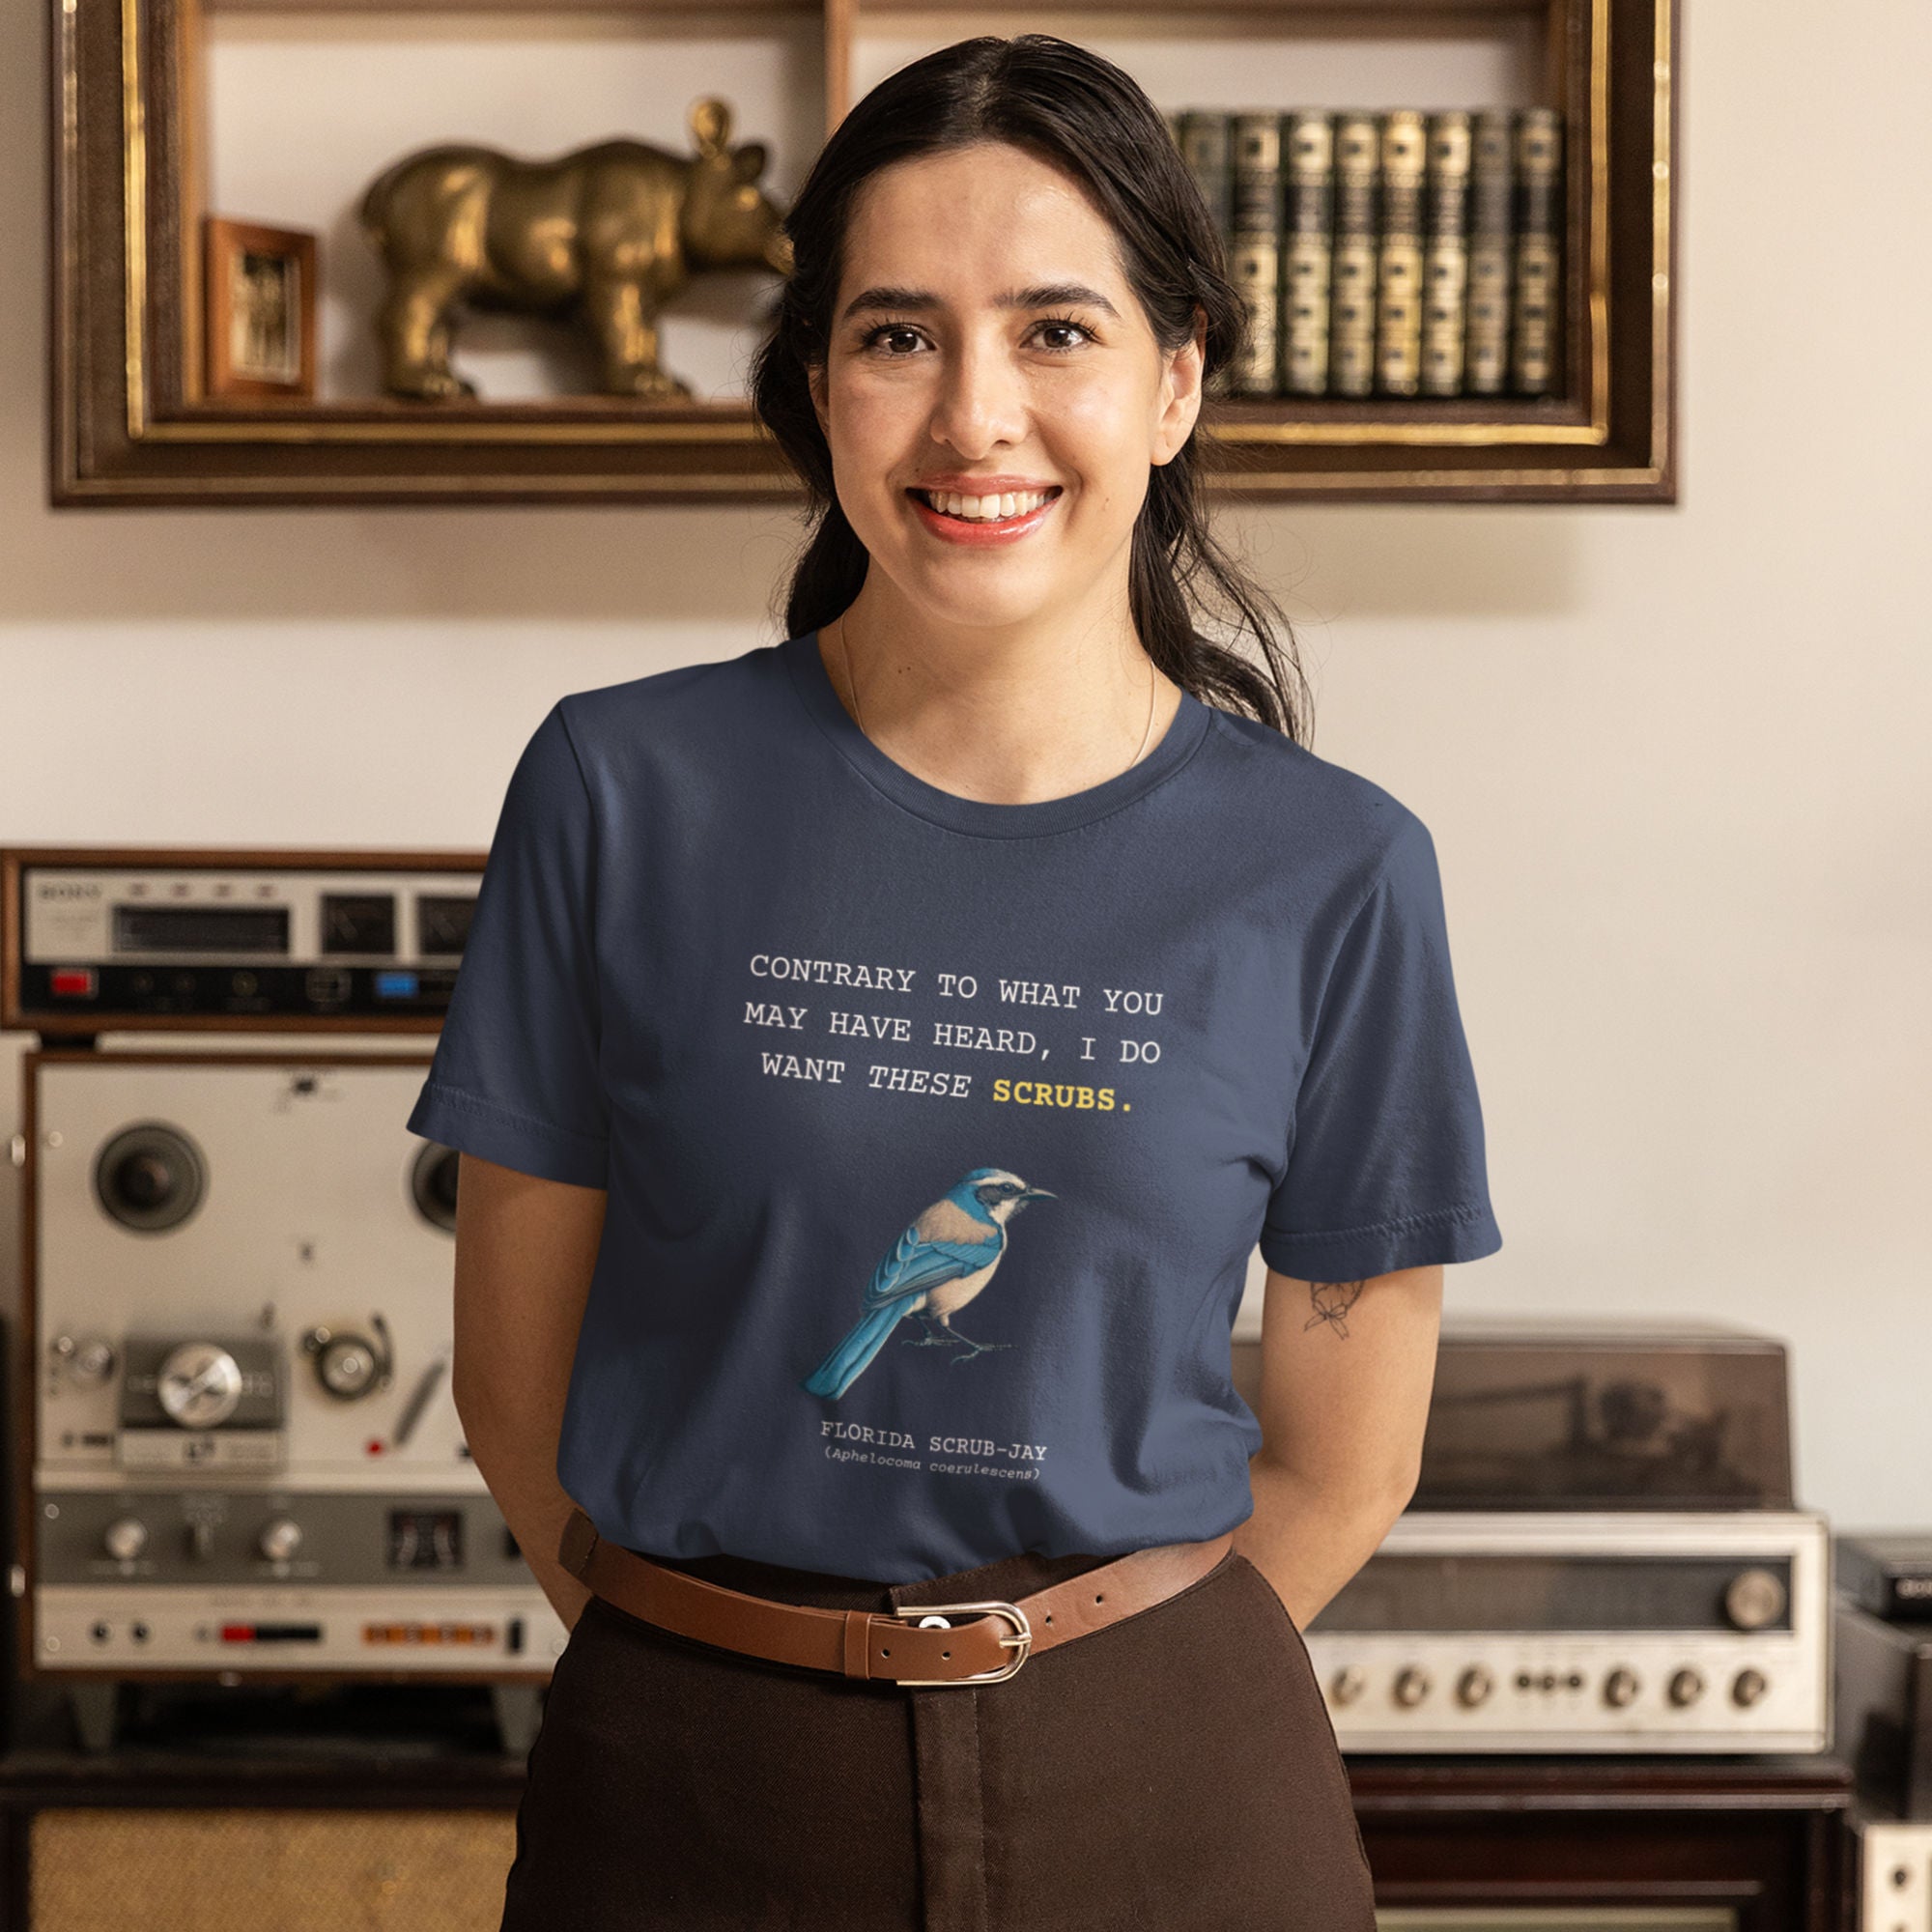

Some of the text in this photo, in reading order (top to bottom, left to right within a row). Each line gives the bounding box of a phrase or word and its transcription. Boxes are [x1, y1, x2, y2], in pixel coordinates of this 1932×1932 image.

[750, 954, 1164, 1015] CONTRARY TO WHAT YOU
[743, 1002, 1161, 1064] MAY HAVE HEARD, I DO
[761, 1053, 1131, 1112] WANT THESE SCRUBS.
[820, 1421, 1048, 1461] FLORIDA SCRUB-JAY
[824, 1445, 1040, 1481] (Aphelocoma coerulescens)
